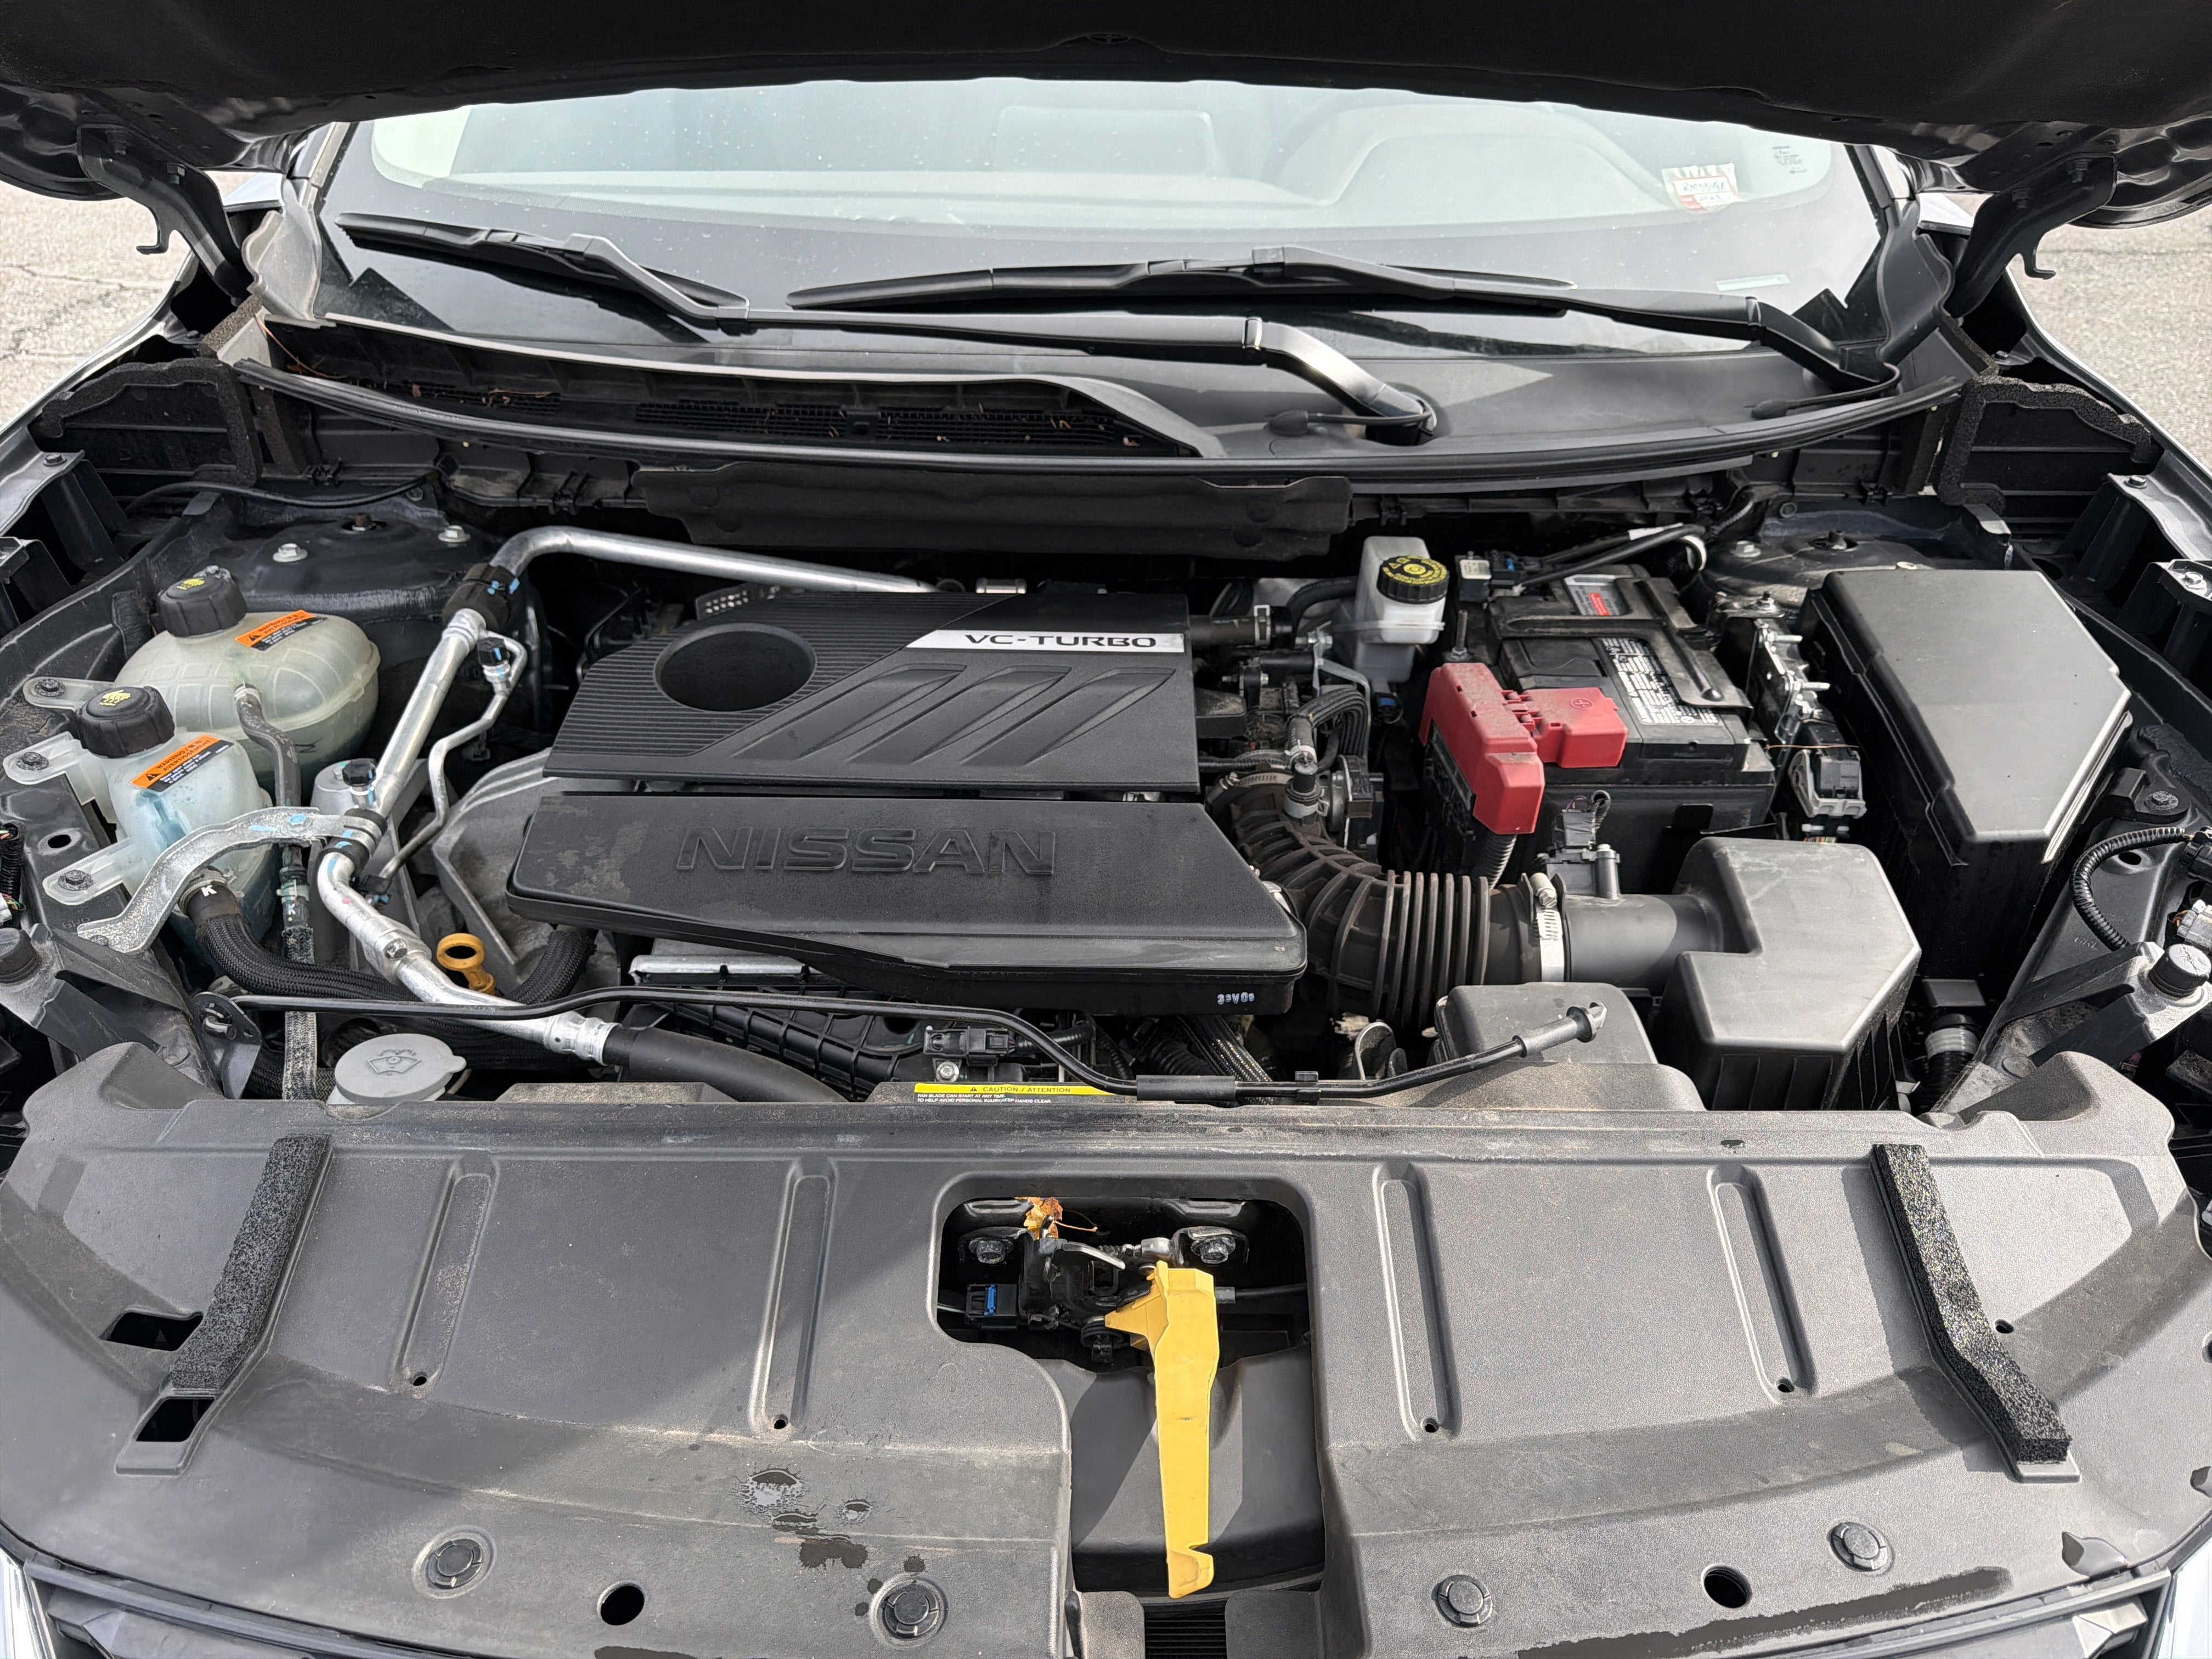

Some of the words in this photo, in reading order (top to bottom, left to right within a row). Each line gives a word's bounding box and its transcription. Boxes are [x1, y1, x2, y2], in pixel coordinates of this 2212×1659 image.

[965, 634, 1156, 647] VC-TURBO
[676, 826, 1055, 874] NISSAN
[201, 884, 217, 897] K
[287, 904, 296, 915] K
